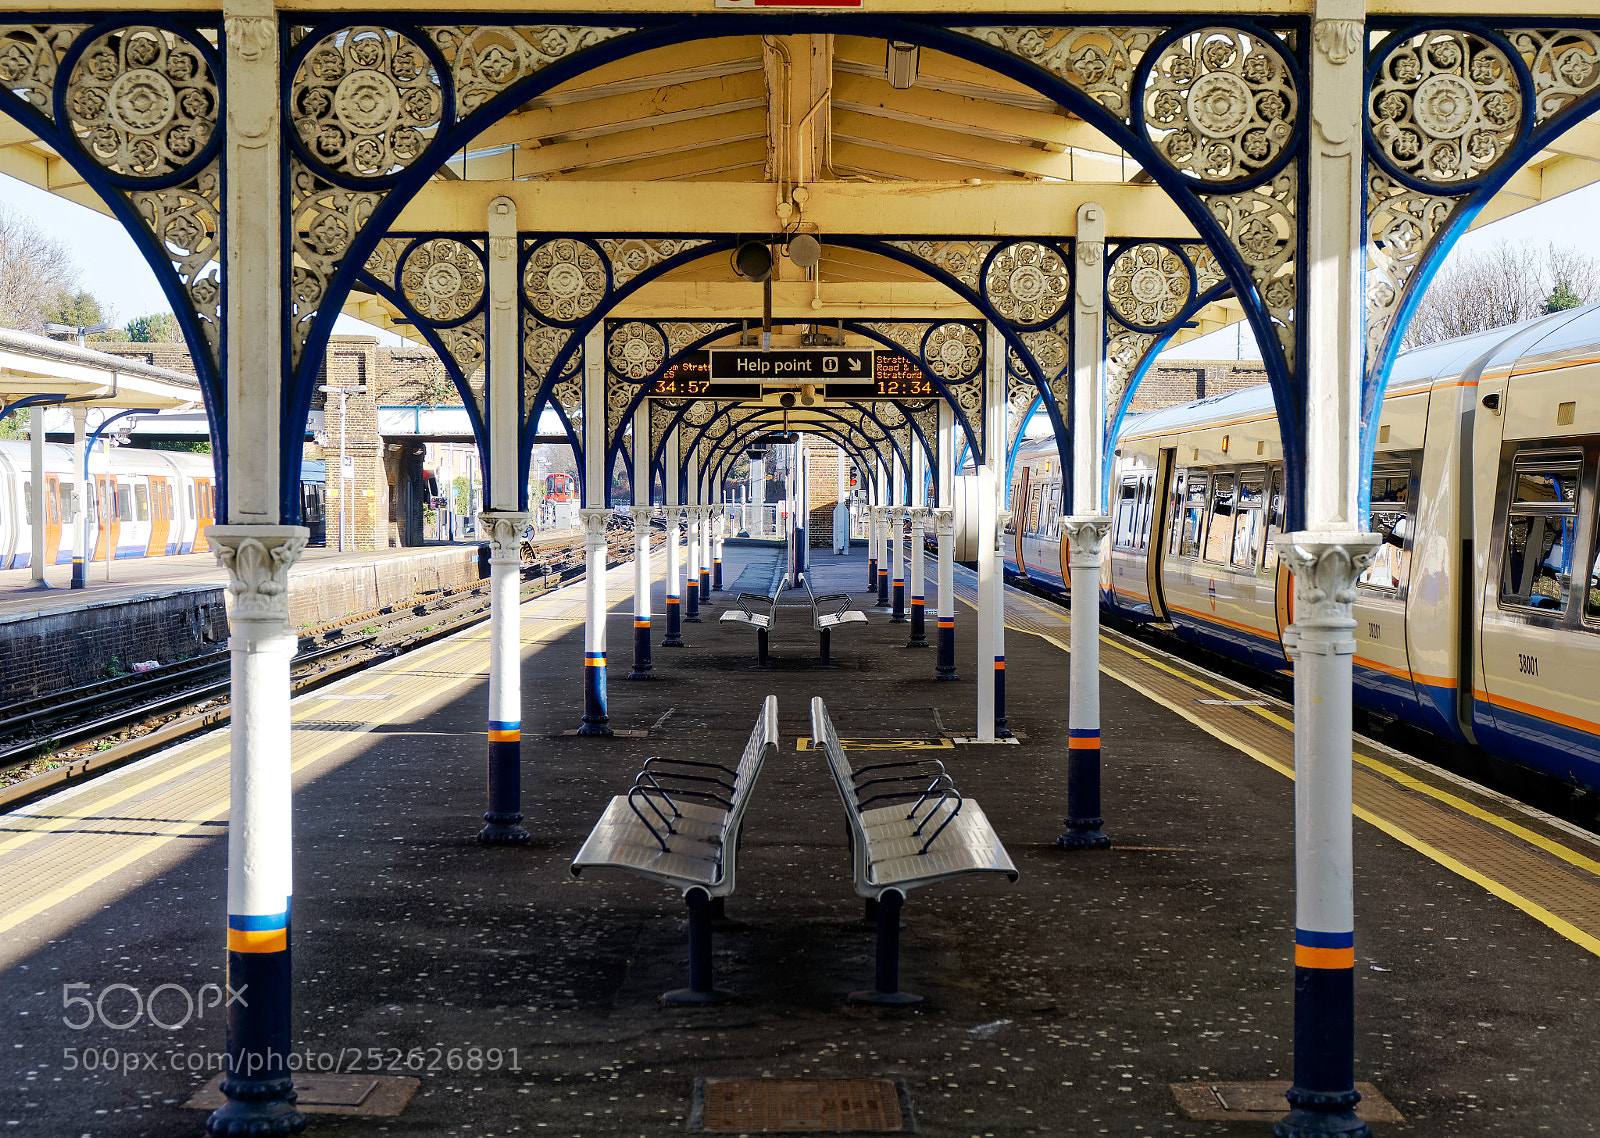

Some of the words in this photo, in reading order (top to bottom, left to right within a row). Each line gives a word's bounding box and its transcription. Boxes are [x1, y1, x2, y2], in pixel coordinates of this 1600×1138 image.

[682, 362, 711, 372] Strat
[737, 358, 770, 375] Help
[775, 358, 812, 375] point
[876, 363, 899, 372] Road
[876, 371, 923, 379] Stratford
[1518, 653, 1539, 677] 38001
